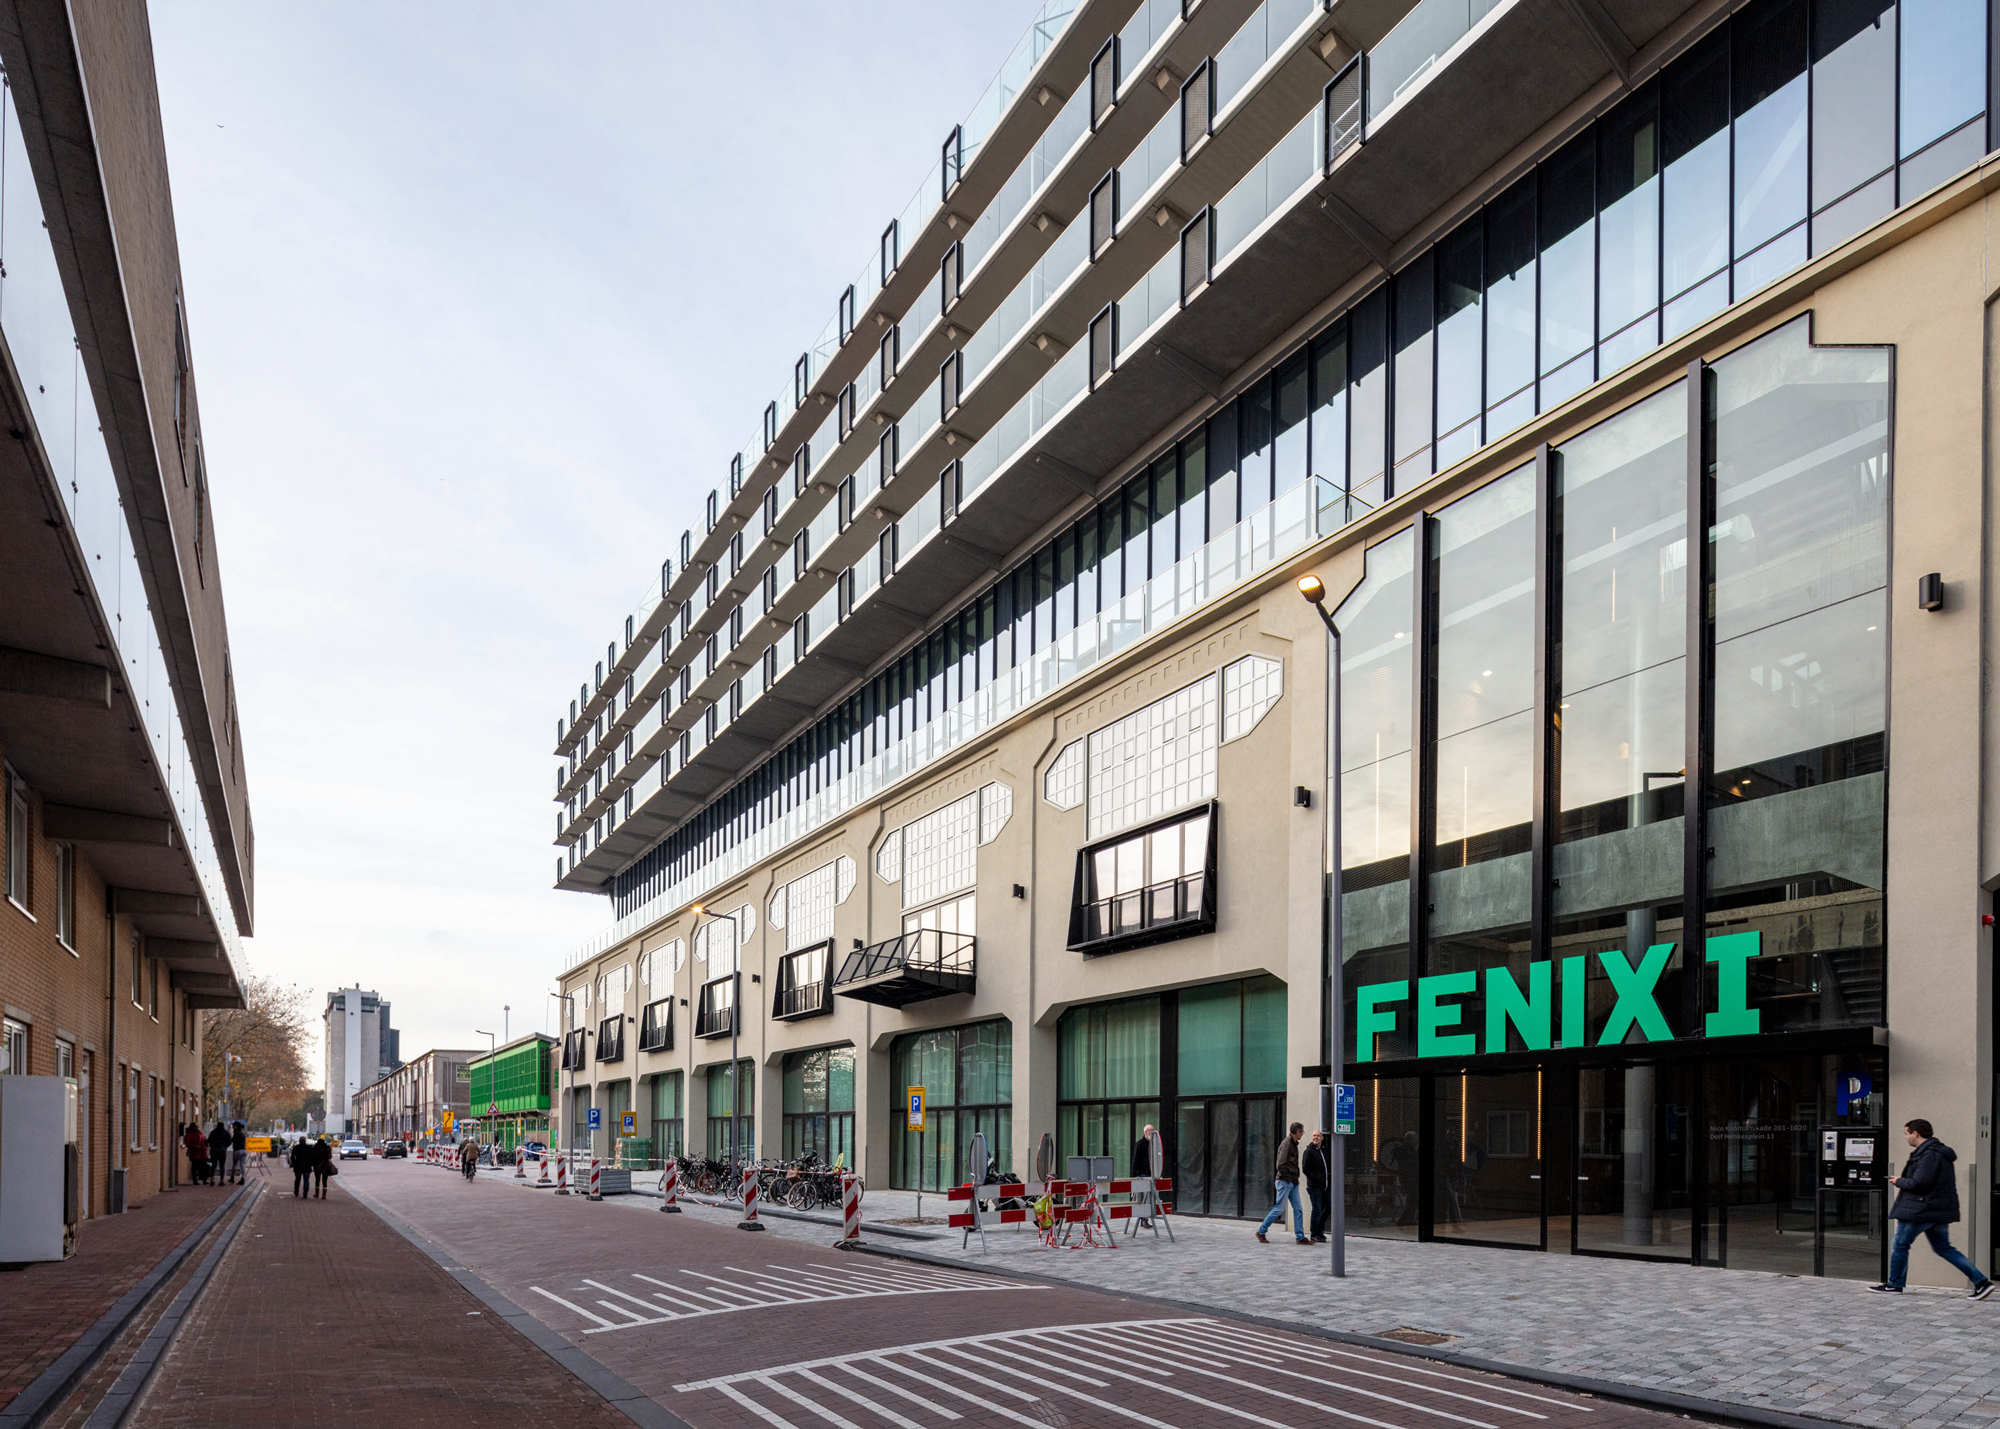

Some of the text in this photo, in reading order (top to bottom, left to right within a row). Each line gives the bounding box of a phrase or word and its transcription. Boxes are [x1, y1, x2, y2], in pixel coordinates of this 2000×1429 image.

[1356, 930, 1763, 1063] FENIX I
[1337, 1086, 1345, 1102] P
[1836, 1072, 1873, 1116] P
[913, 1097, 920, 1111] P
[590, 1110, 598, 1122] P
[625, 1116, 632, 1125] P
